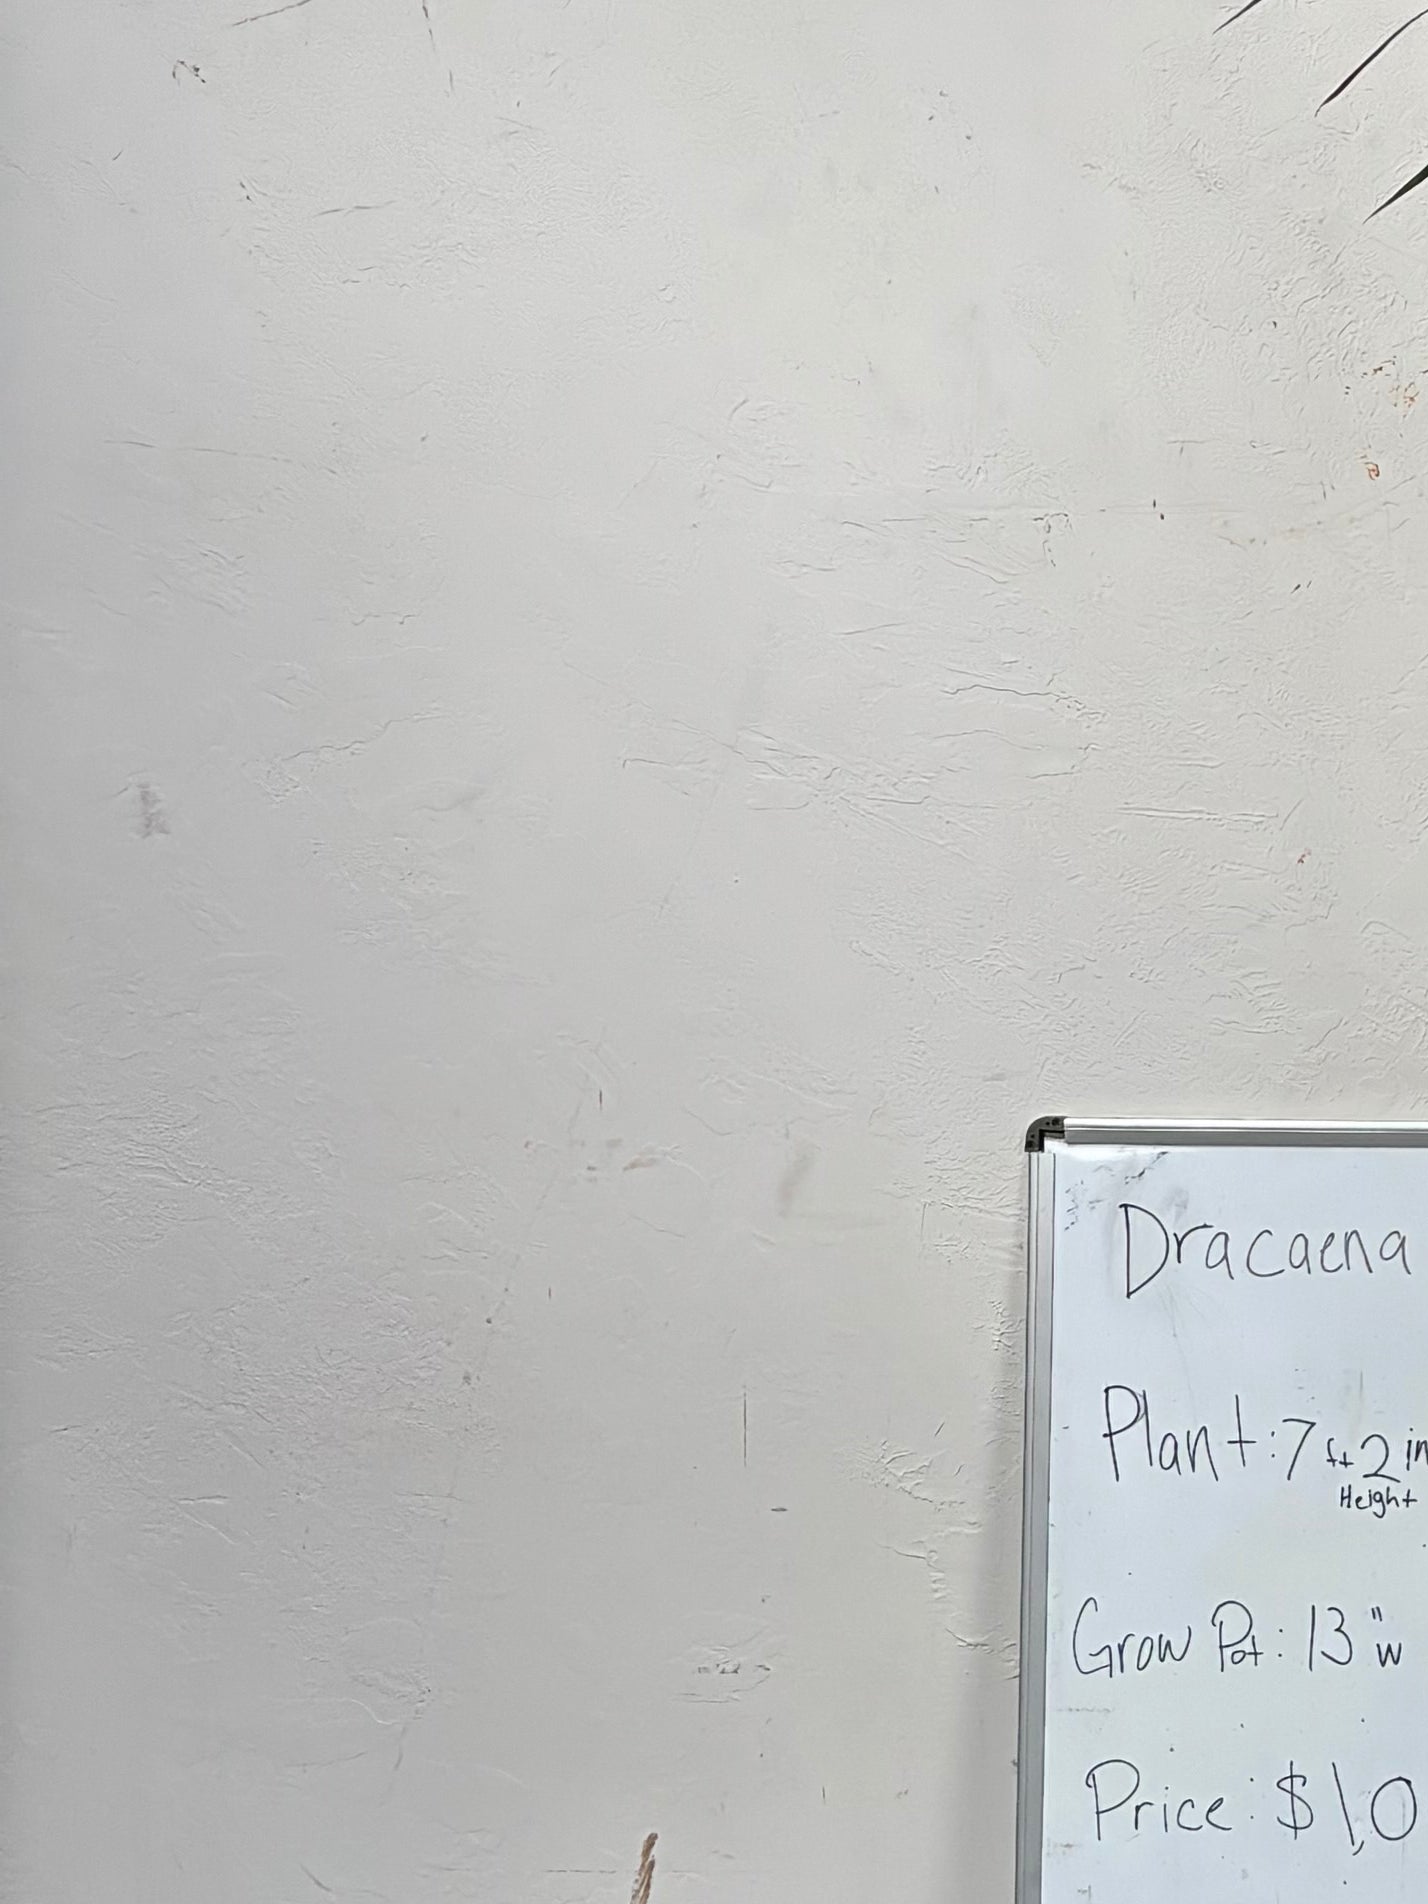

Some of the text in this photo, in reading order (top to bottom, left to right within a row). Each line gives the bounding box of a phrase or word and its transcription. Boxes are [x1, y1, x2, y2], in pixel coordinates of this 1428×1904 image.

[1118, 1202, 1412, 1299] Dracaena
[1340, 1485, 1418, 1518] Height
[1072, 1596, 1192, 1678] Grow
[1211, 1599, 1284, 1673] Pot:
[1085, 1758, 1255, 1842] Price:
